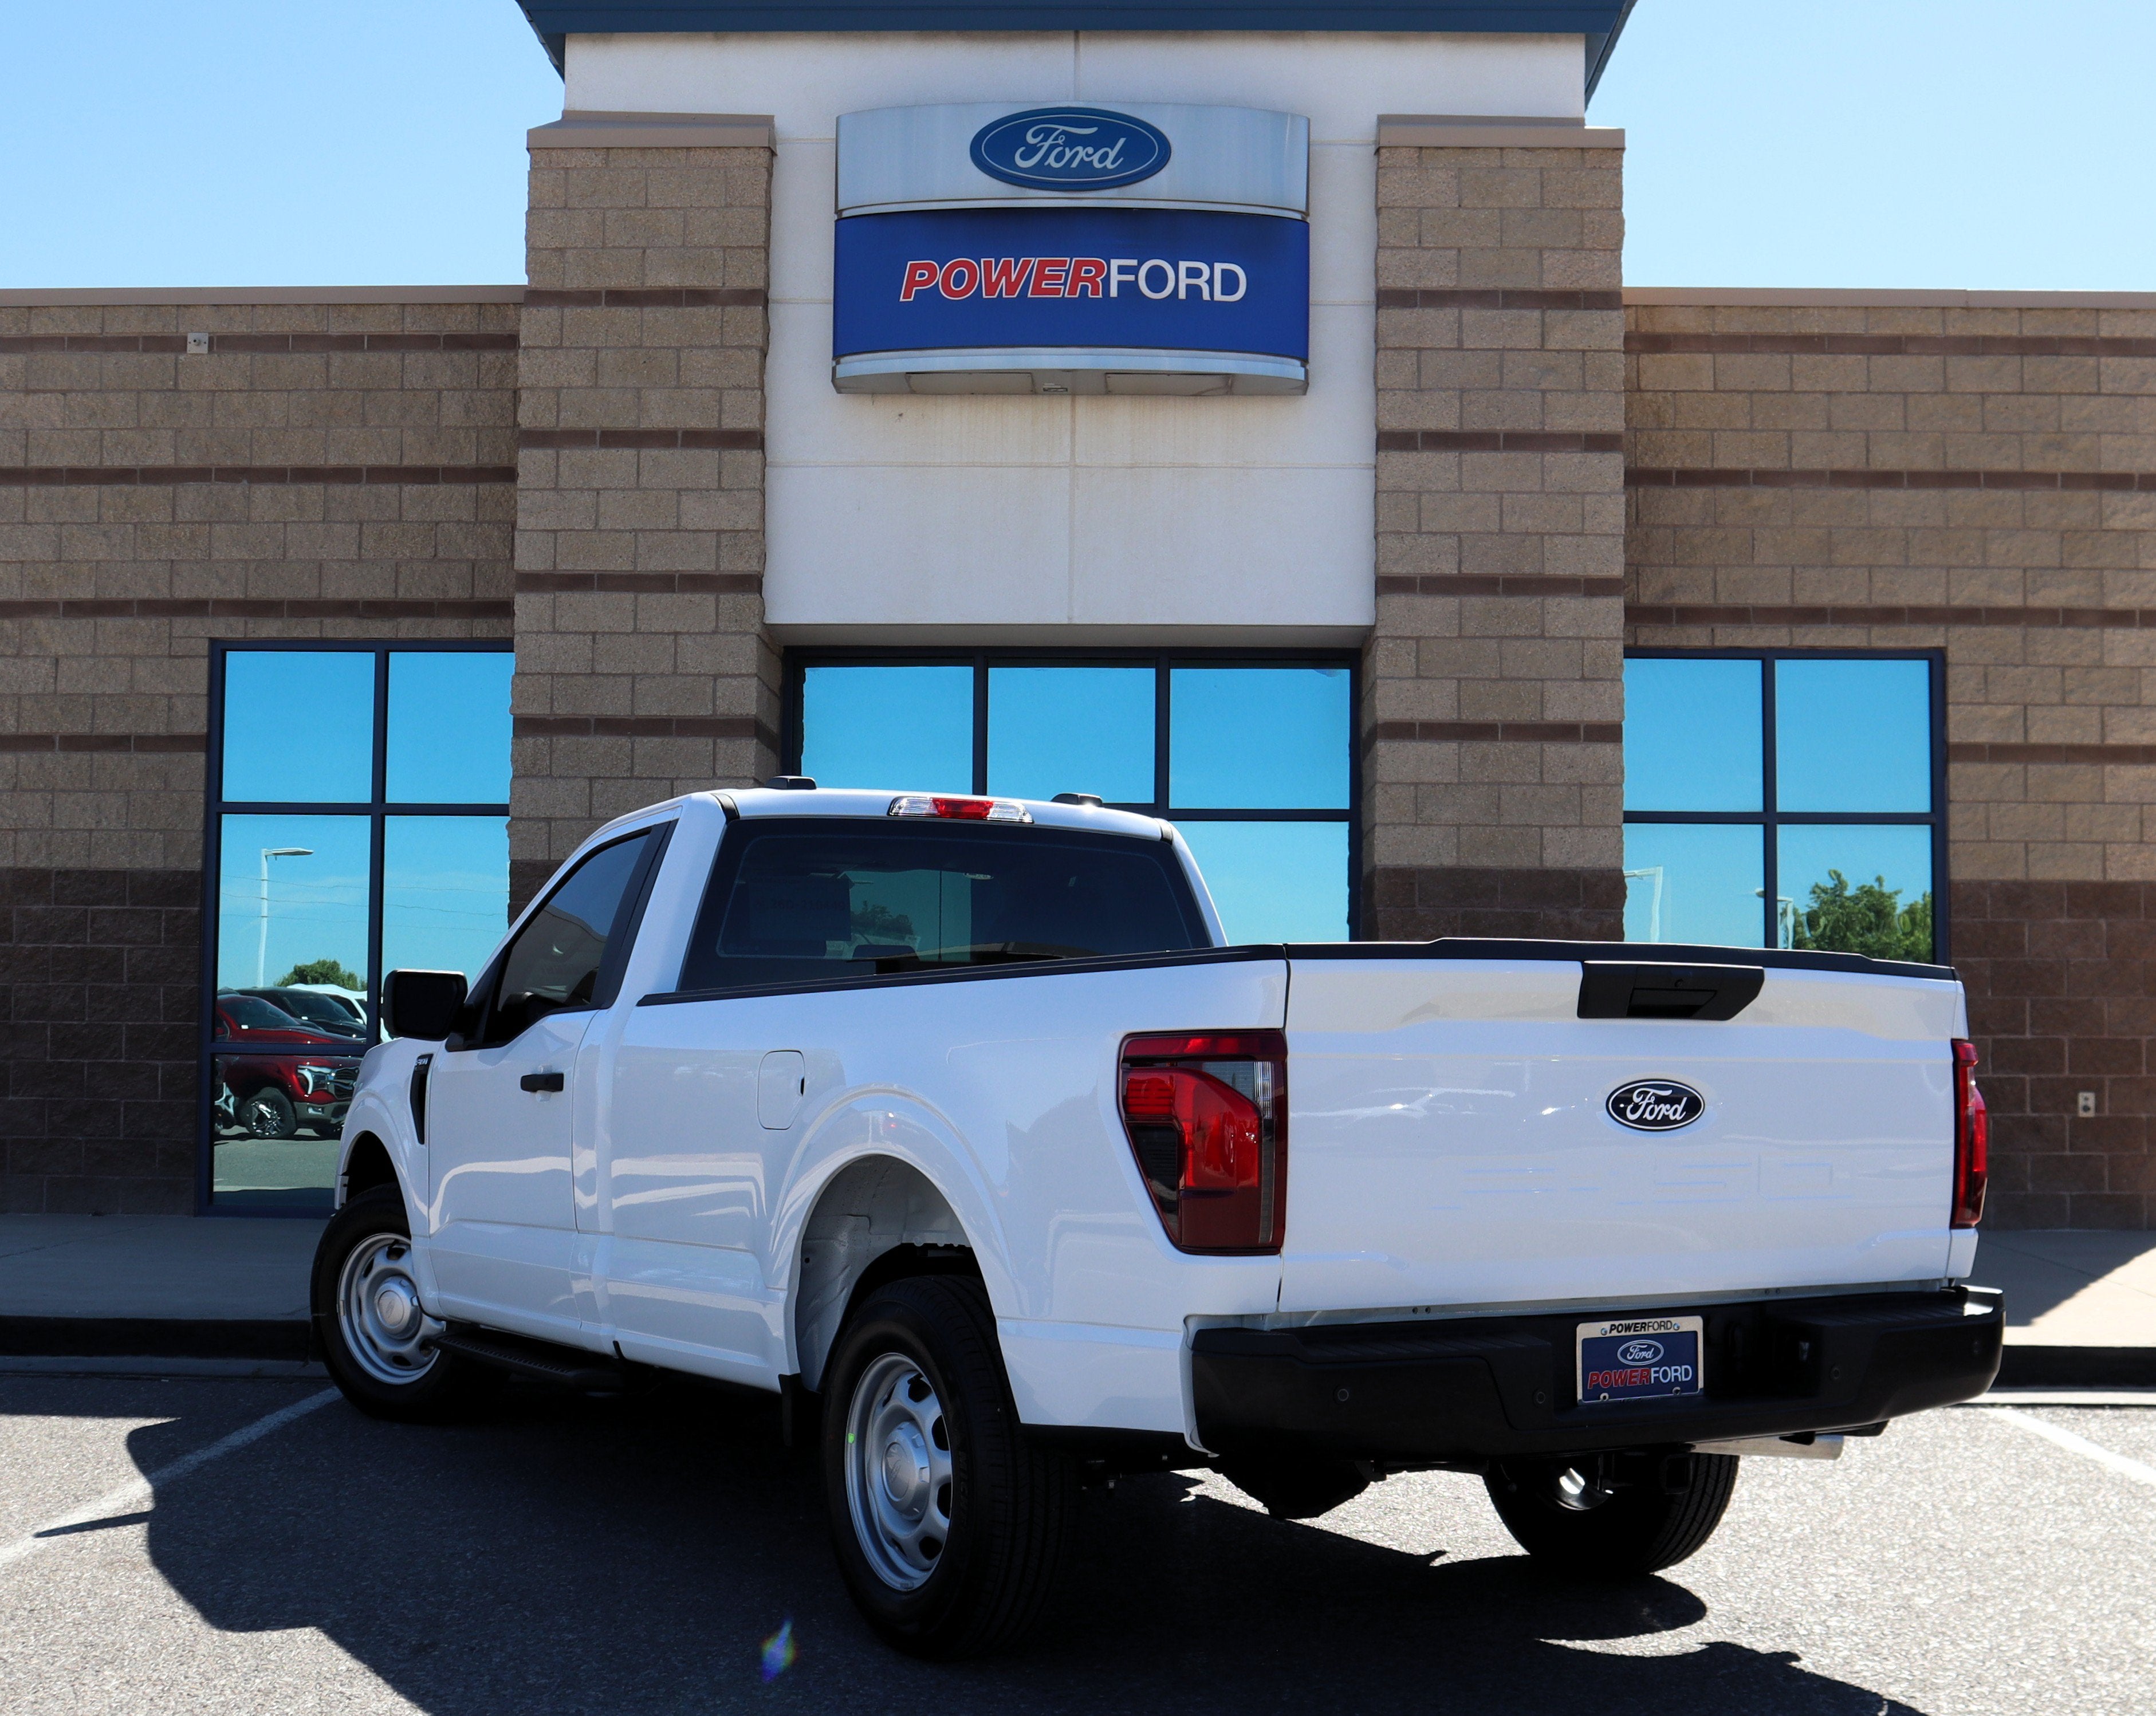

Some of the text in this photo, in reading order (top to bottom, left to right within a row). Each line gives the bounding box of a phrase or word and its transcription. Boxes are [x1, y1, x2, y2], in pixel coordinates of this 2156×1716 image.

[1014, 123, 1126, 170] Ford
[1626, 1088, 1687, 1120] Ford
[1627, 1344, 1654, 1360] Ford
